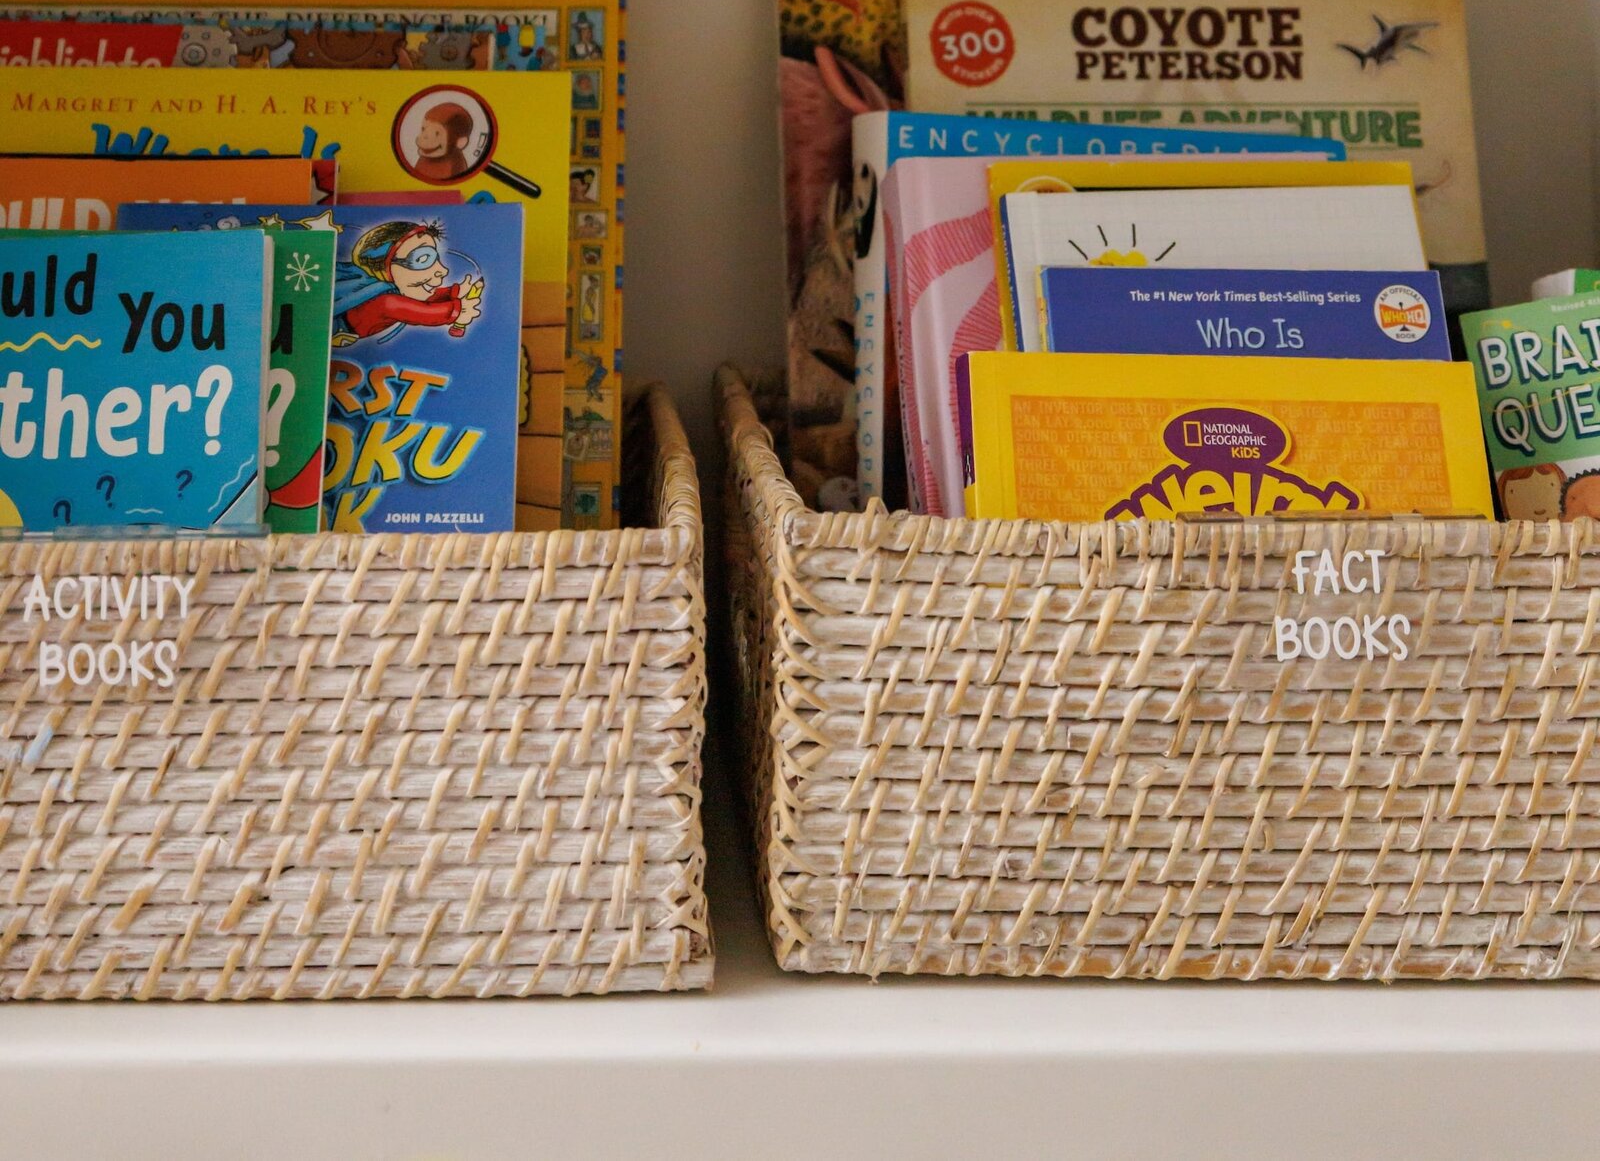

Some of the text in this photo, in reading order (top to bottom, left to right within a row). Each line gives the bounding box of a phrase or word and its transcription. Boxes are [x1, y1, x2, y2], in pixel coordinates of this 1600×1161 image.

[938, 28, 1006, 62] 300
[1071, 7, 1303, 49] COYOTE
[1076, 52, 1304, 81] PETERSON
[11, 92, 377, 116] MARGRET AND H. A. REY'S
[899, 125, 1251, 156] ENCYCLOPE
[0, 253, 98, 318] uld
[1130, 291, 1362, 306] The #1 New York Times Best-Selling Series
[1196, 317, 1305, 349] Who Is
[330, 359, 450, 416] RST
[0, 364, 234, 460] ther?
[1203, 424, 1253, 435] NATIONAL
[1203, 435, 1267, 446] GEOGRAPHIC
[385, 513, 484, 524] JOHN PAZZELLI
[1292, 547, 1386, 596] FACT
[23, 574, 196, 622] ACTIVITY
[1274, 614, 1411, 662] BOOKS
[38, 639, 178, 688] BOOKS
